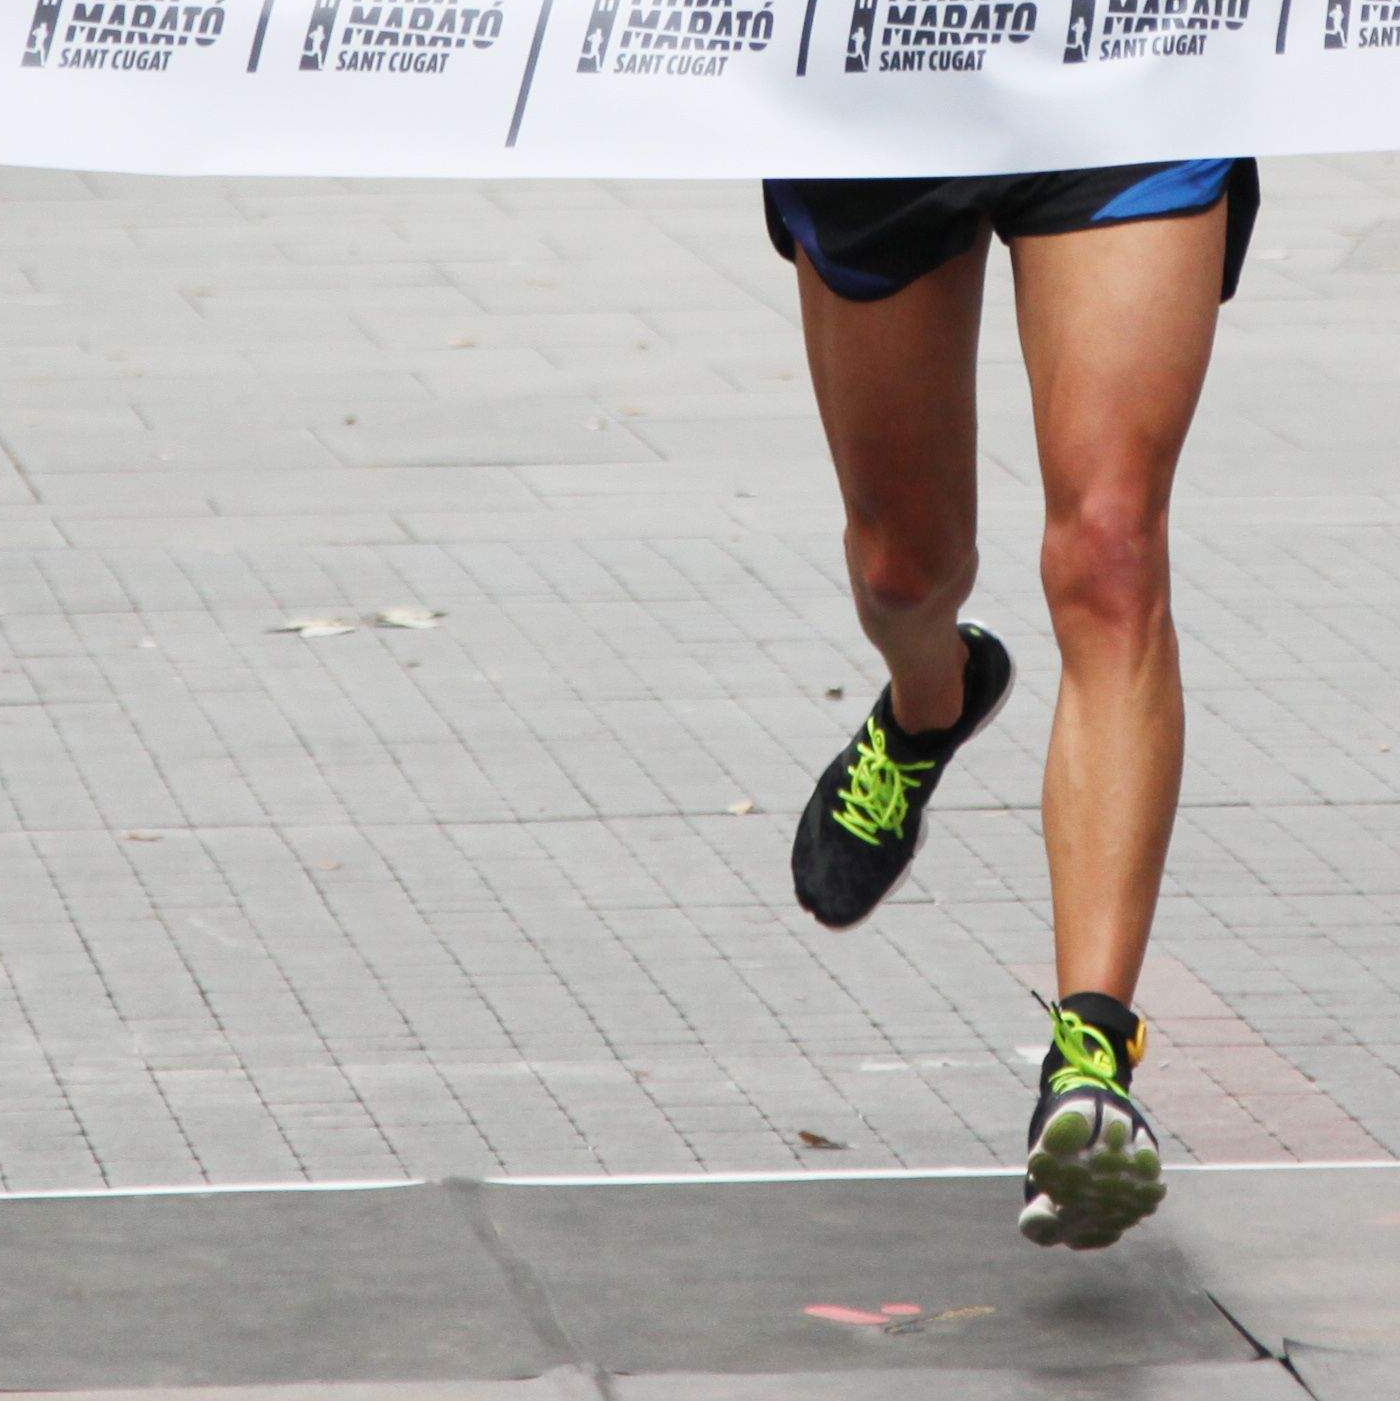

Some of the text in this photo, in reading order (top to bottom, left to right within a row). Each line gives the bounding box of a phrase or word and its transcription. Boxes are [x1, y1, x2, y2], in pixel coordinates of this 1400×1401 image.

[341, 1, 504, 49] MARATÓ
[619, 2, 774, 51] MARATÓ
[1100, 34, 1207, 60] SANT CUGAT
[58, 49, 172, 71] SANT CUGAT
[336, 51, 450, 73] SANT CUGAT
[613, 54, 728, 76] SANT CUGAT
[879, 50, 985, 70] SANT CUGAT
